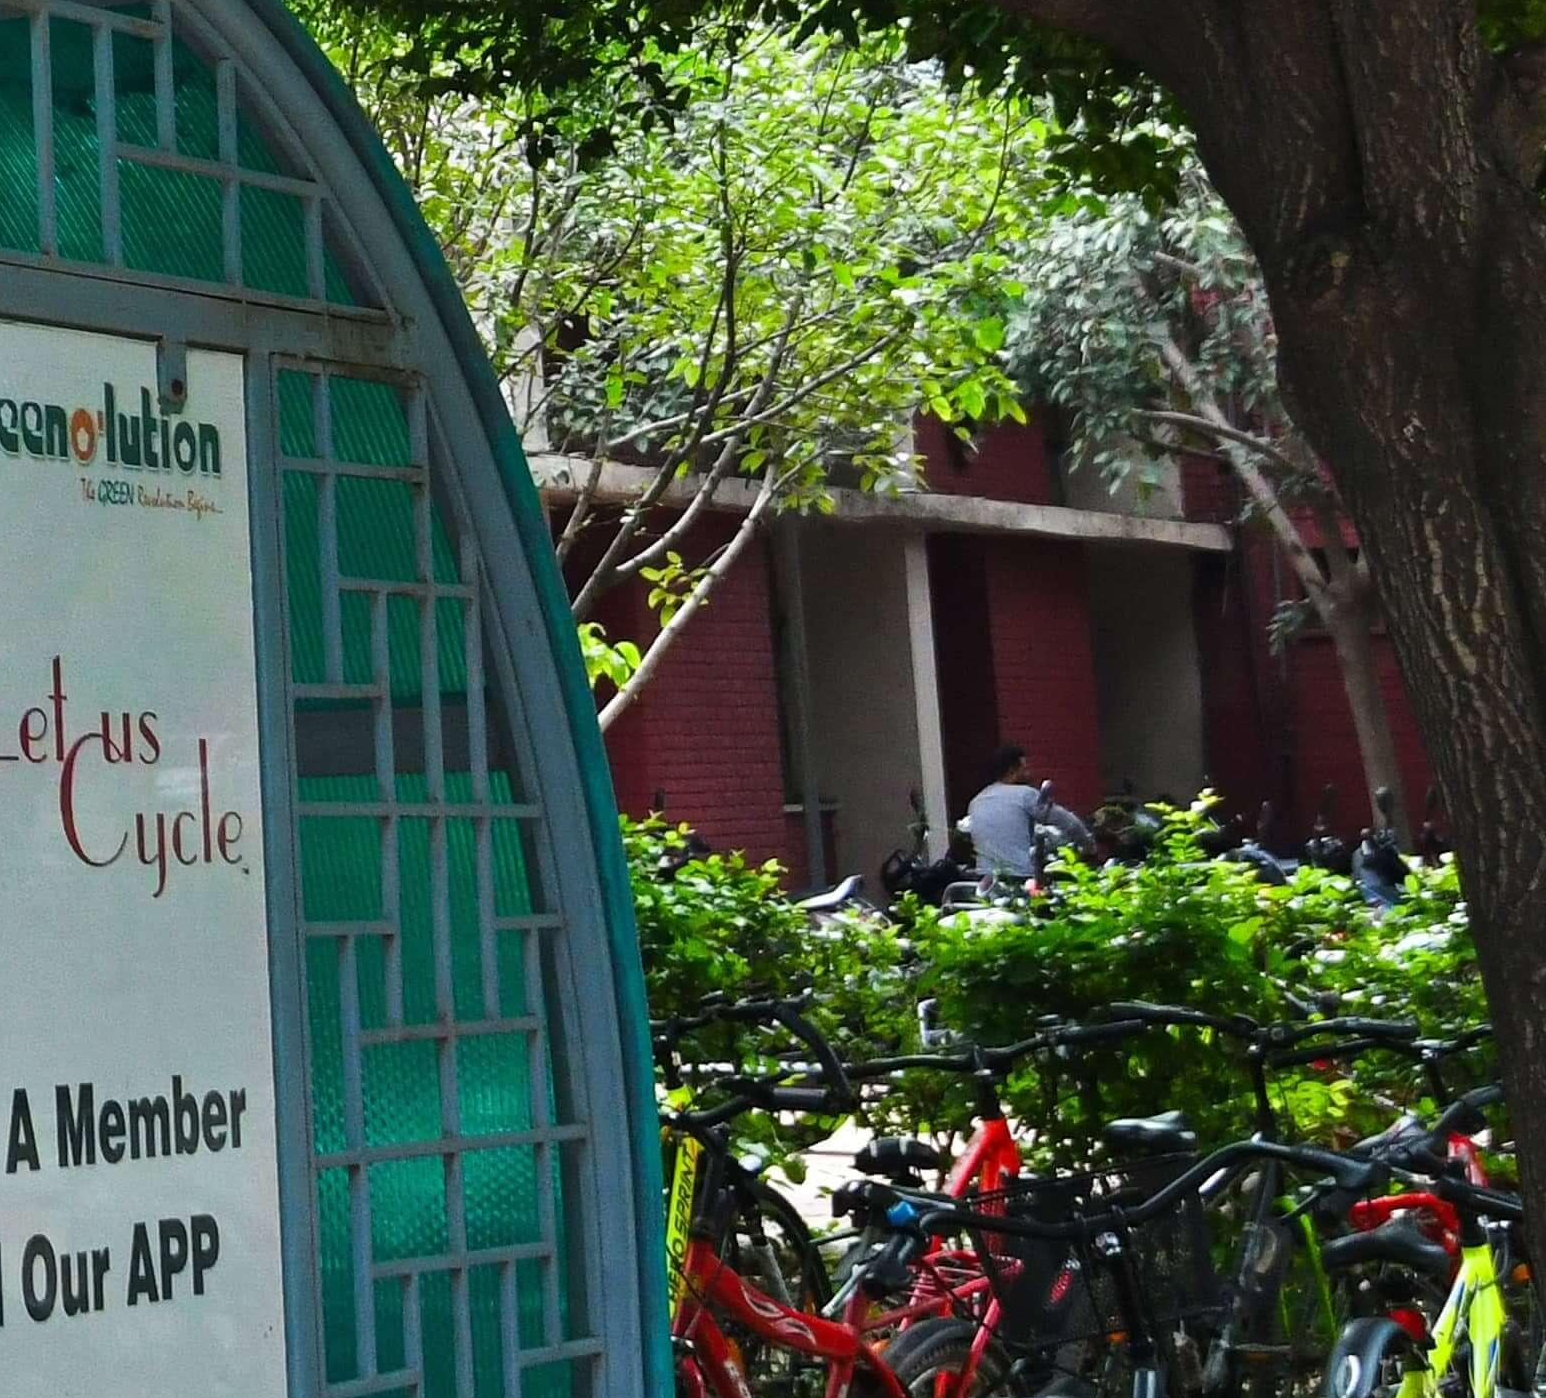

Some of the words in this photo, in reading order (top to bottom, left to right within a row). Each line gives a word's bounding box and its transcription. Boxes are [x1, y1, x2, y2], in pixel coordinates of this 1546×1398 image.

[100, 707, 161, 765] us
[58, 733, 244, 899] Cycle
[5, 1088, 41, 1173] A
[54, 1075, 247, 1169] Member
[674, 1141, 698, 1235] SPRINT
[21, 1233, 110, 1323] Our
[126, 1214, 221, 1306] APP
